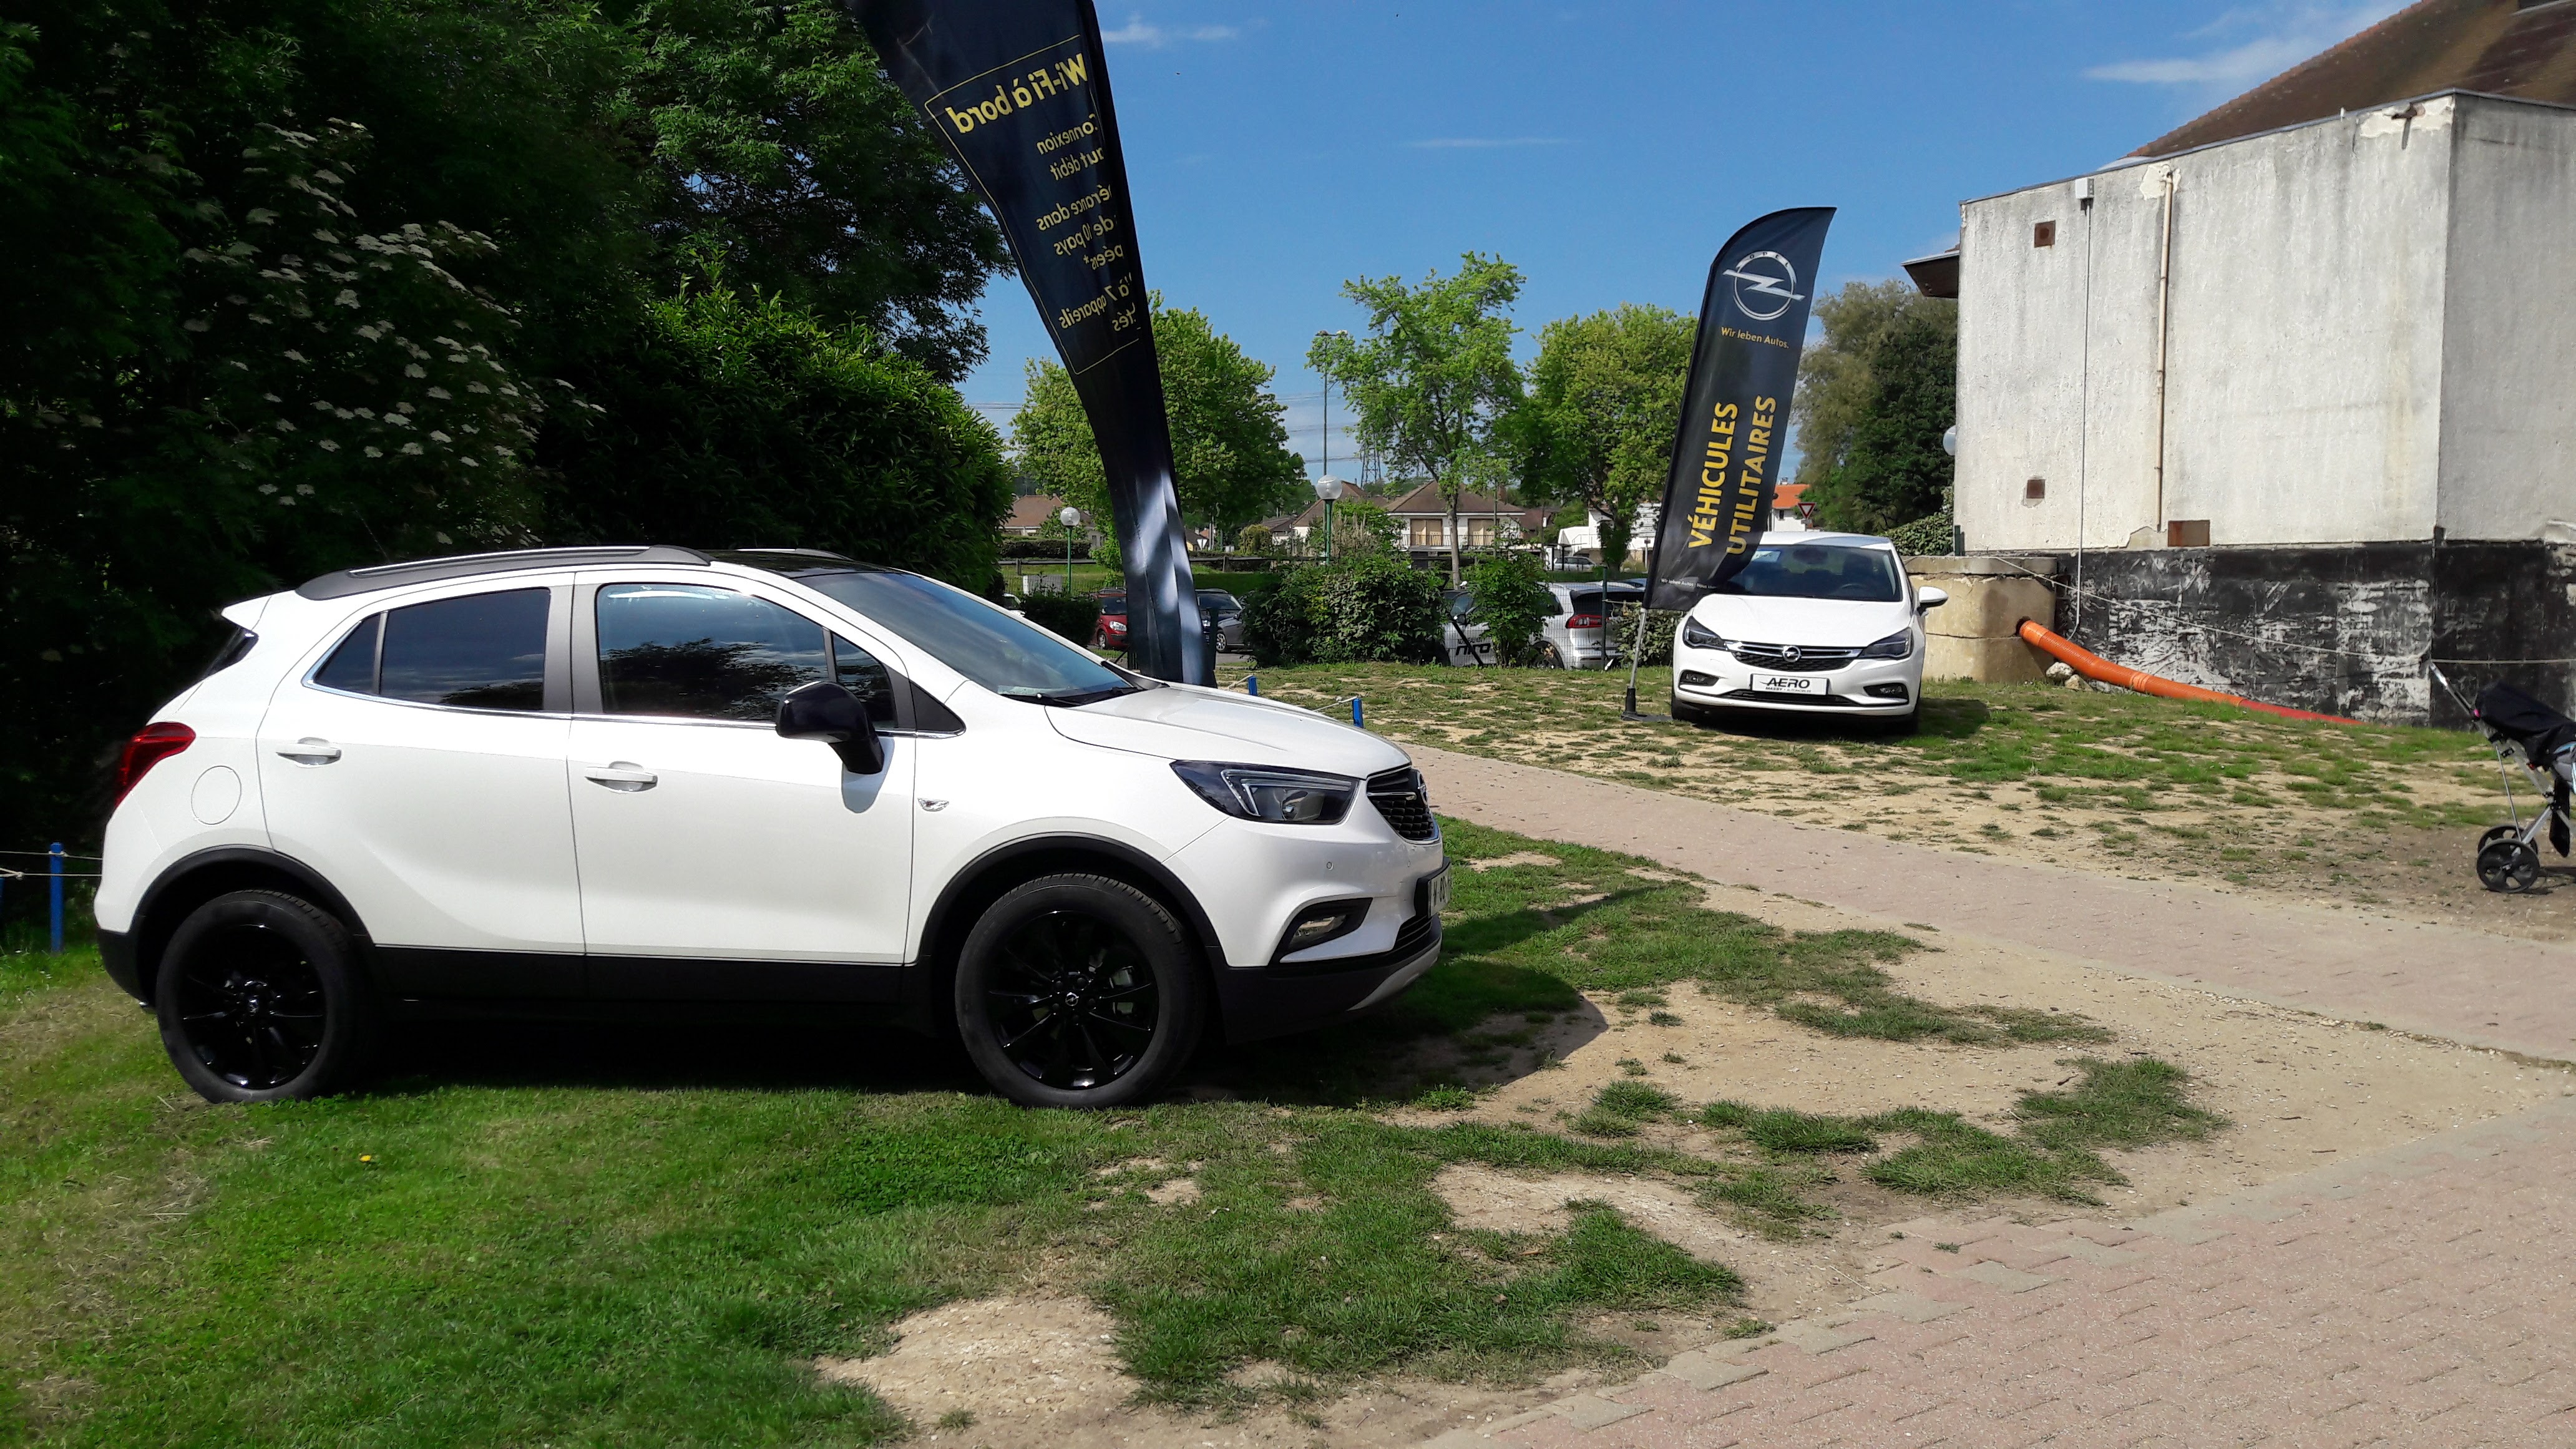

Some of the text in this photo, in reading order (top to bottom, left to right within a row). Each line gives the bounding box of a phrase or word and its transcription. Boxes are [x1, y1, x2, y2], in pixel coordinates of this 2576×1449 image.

[1749, 251, 1789, 268] OPEL
[1721, 326, 1789, 349] Wir leben Autos.
[1687, 402, 1738, 549] VÉHICULES
[1726, 396, 1776, 555] UTILITAIRES
[1767, 678, 1810, 689] AERO
